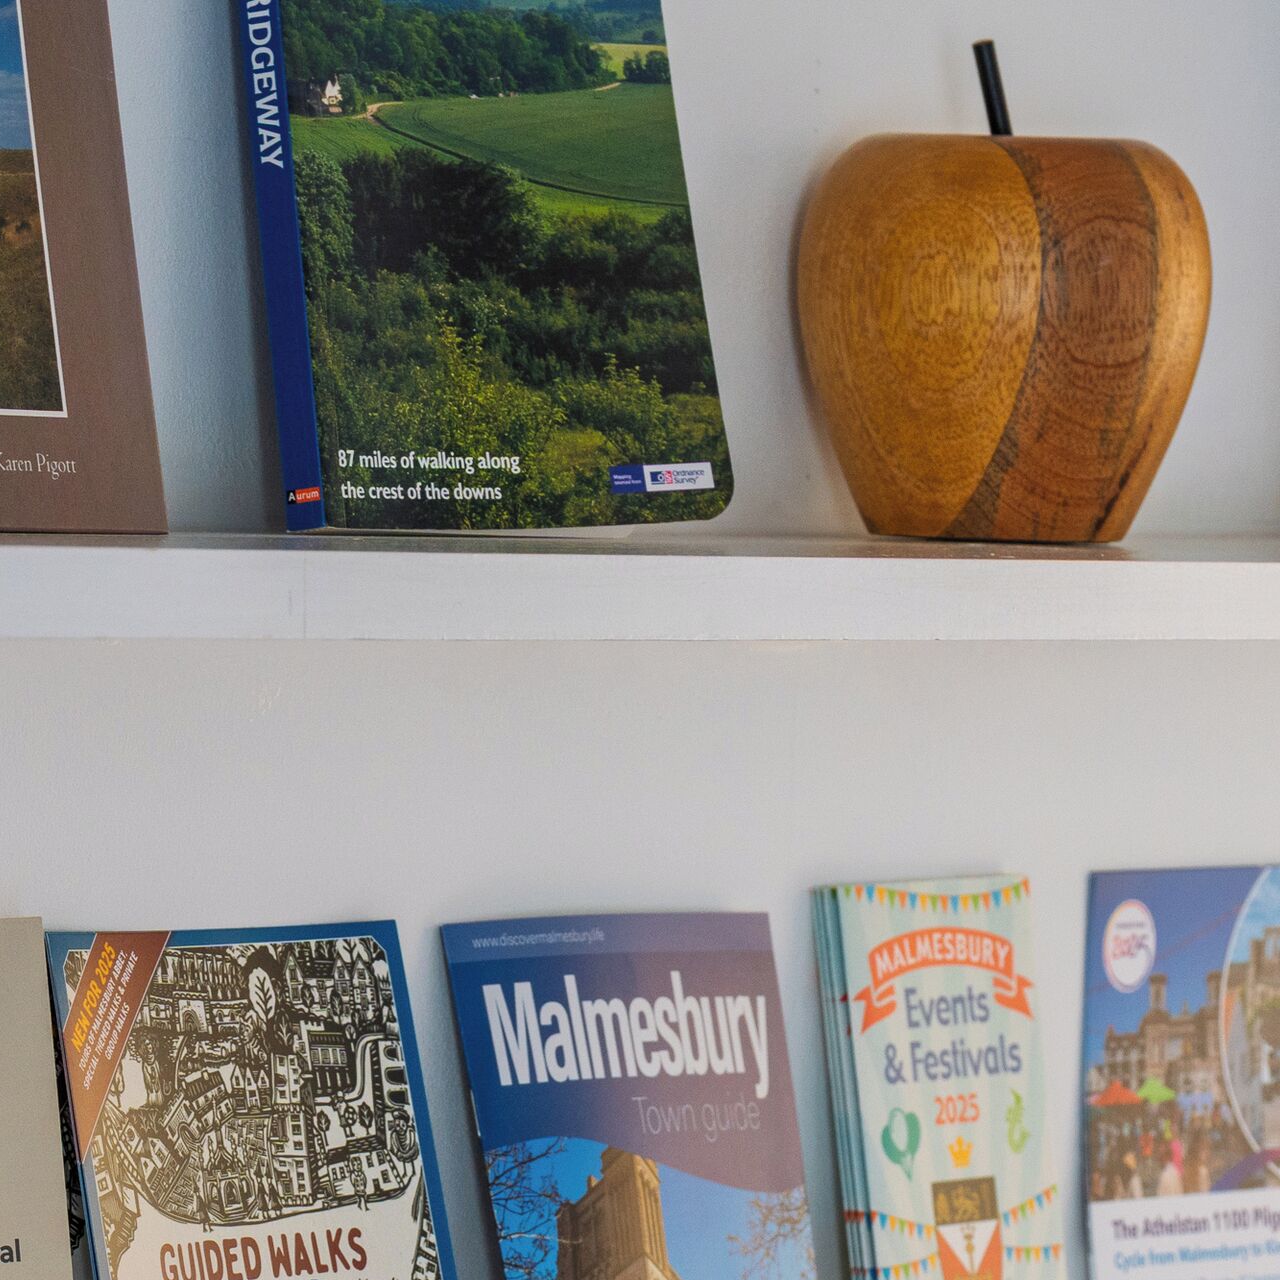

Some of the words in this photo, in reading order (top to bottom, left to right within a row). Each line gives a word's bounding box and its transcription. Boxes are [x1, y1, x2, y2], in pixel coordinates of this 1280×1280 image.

[36, 453, 77, 480] Pigott
[337, 449, 355, 468] 87
[359, 450, 397, 469] miles
[400, 450, 416, 469] of
[417, 450, 474, 474] walking
[477, 451, 521, 474] along
[288, 488, 320, 501] Aurum
[341, 480, 365, 499] the
[368, 483, 404, 500] crest
[409, 482, 422, 500] of
[424, 482, 450, 500] the
[453, 482, 502, 500] downs
[874, 931, 1011, 981] MALMESBURY
[71, 1009, 91, 1052] NEW
[83, 980, 103, 1018] FOR
[95, 942, 117, 984] 2025
[93, 981, 116, 1030] MALMESBURY
[904, 985, 991, 1029] Events
[83, 1055, 100, 1090] SPECIAL
[95, 1022, 111, 1055] THEMED
[109, 996, 122, 1023] WALKS
[120, 951, 139, 984] PRIVATE
[89, 1029, 98, 1045] OF
[104, 1032, 119, 1061] GROUP
[116, 1002, 131, 1033] WALKS
[482, 970, 769, 1099] Malmesbury
[78, 1045, 92, 1072] TOURS
[883, 1043, 907, 1085] &
[910, 1034, 1023, 1081] Festivals
[632, 1095, 697, 1135] Town
[702, 1093, 761, 1142] guide
[933, 1094, 981, 1126] 2025
[268, 1227, 368, 1277] WALKS
[1111, 1219, 1139, 1240] The
